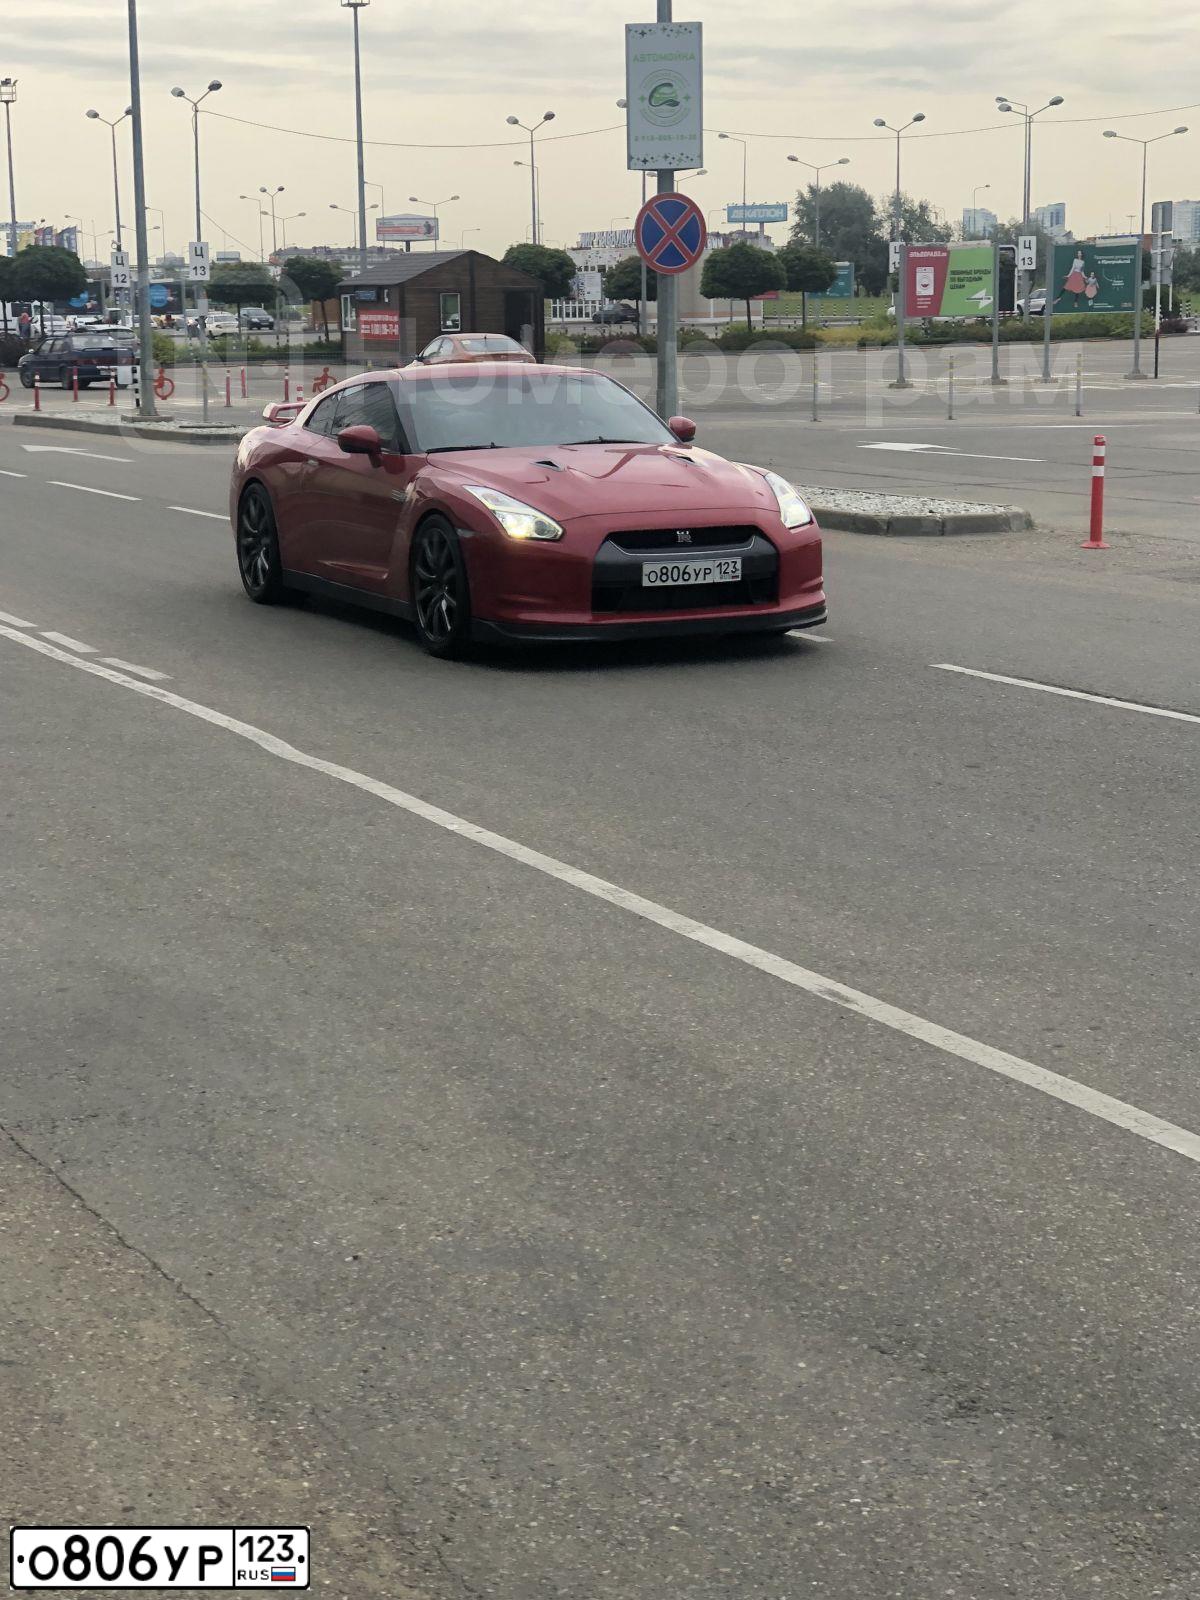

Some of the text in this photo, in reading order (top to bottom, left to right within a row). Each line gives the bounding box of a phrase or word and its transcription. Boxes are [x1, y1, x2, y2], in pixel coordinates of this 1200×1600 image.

[1024, 239, 1032, 250] Ц
[195, 246, 204, 258] Ц
[115, 256, 124, 267] Ц
[1021, 256, 1033, 266] 13
[193, 265, 207, 276] 13
[113, 273, 127, 283] 12
[716, 560, 738, 575] 123
